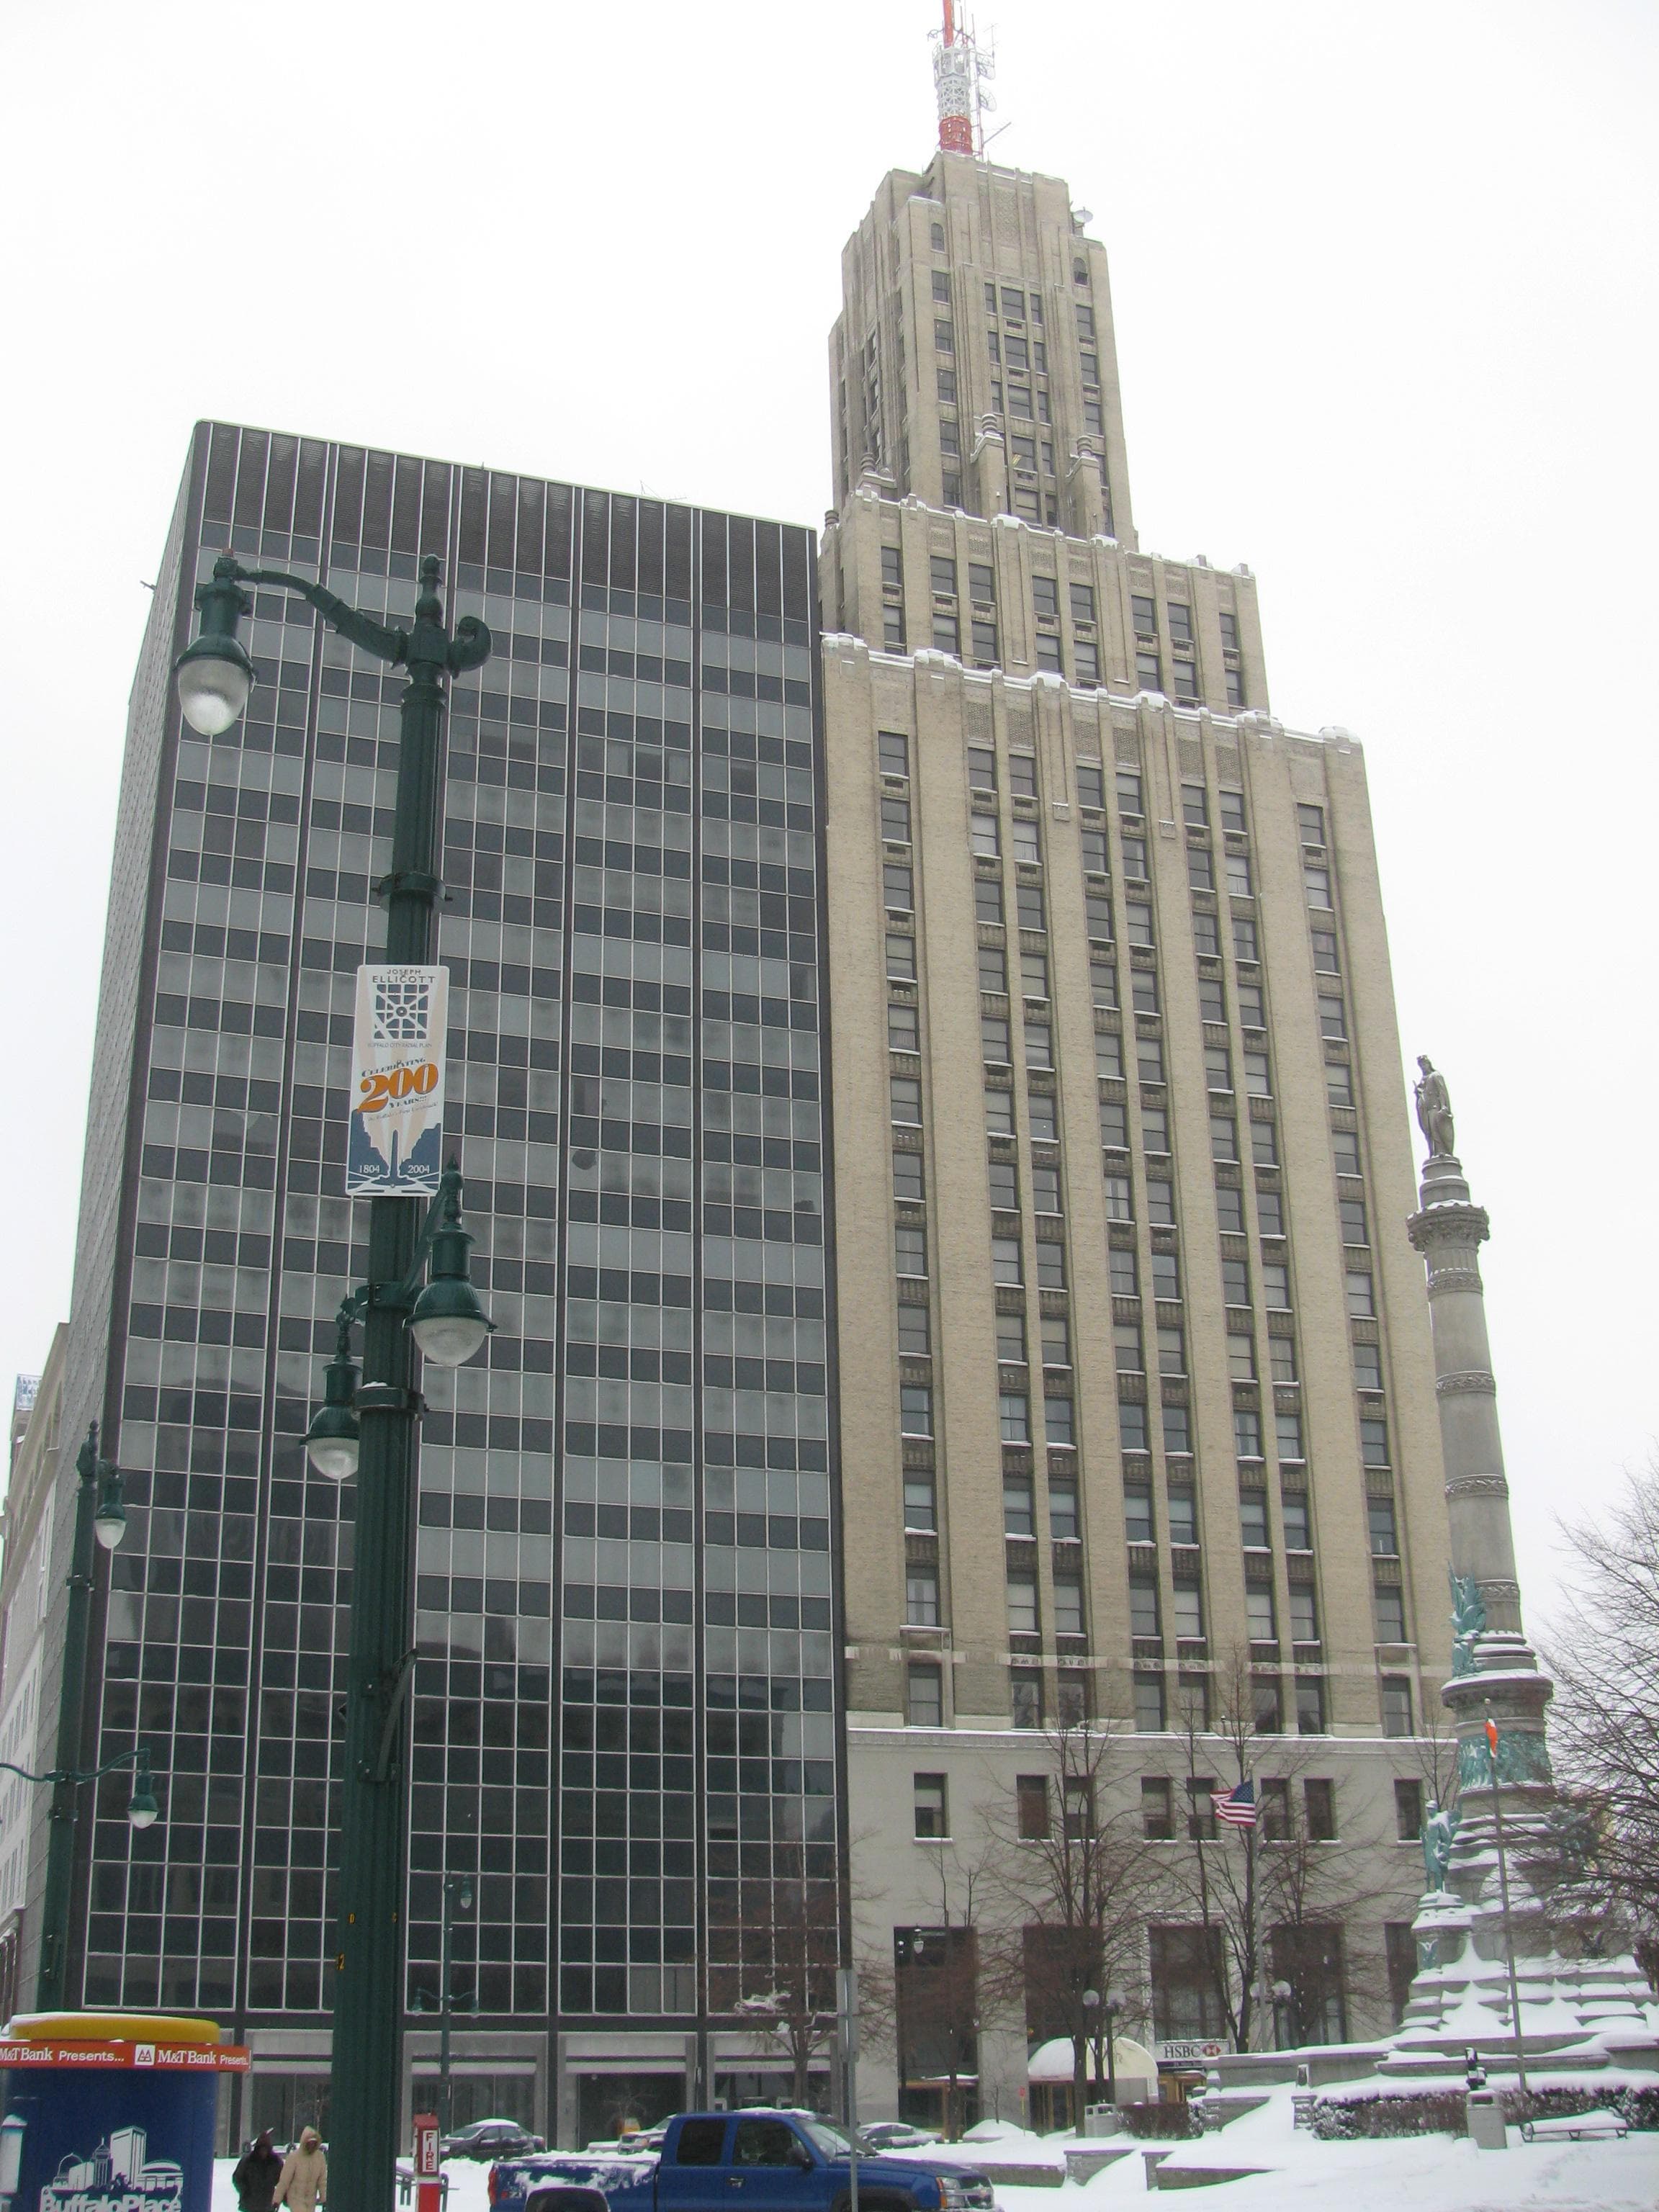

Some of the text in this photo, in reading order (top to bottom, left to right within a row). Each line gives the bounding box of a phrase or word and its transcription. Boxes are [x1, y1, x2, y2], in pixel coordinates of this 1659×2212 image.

[359, 1064, 439, 1114] 200
[359, 1164, 380, 1174] 1804
[408, 1164, 430, 1174] 2004
[21, 2047, 53, 2062] Bank
[59, 2051, 125, 2062] Presents...
[158, 2049, 186, 2064] M&T
[187, 2051, 216, 2064] Bank
[1164, 2046, 1200, 2059] HSBC
[426, 2132, 435, 2170] FIRE
